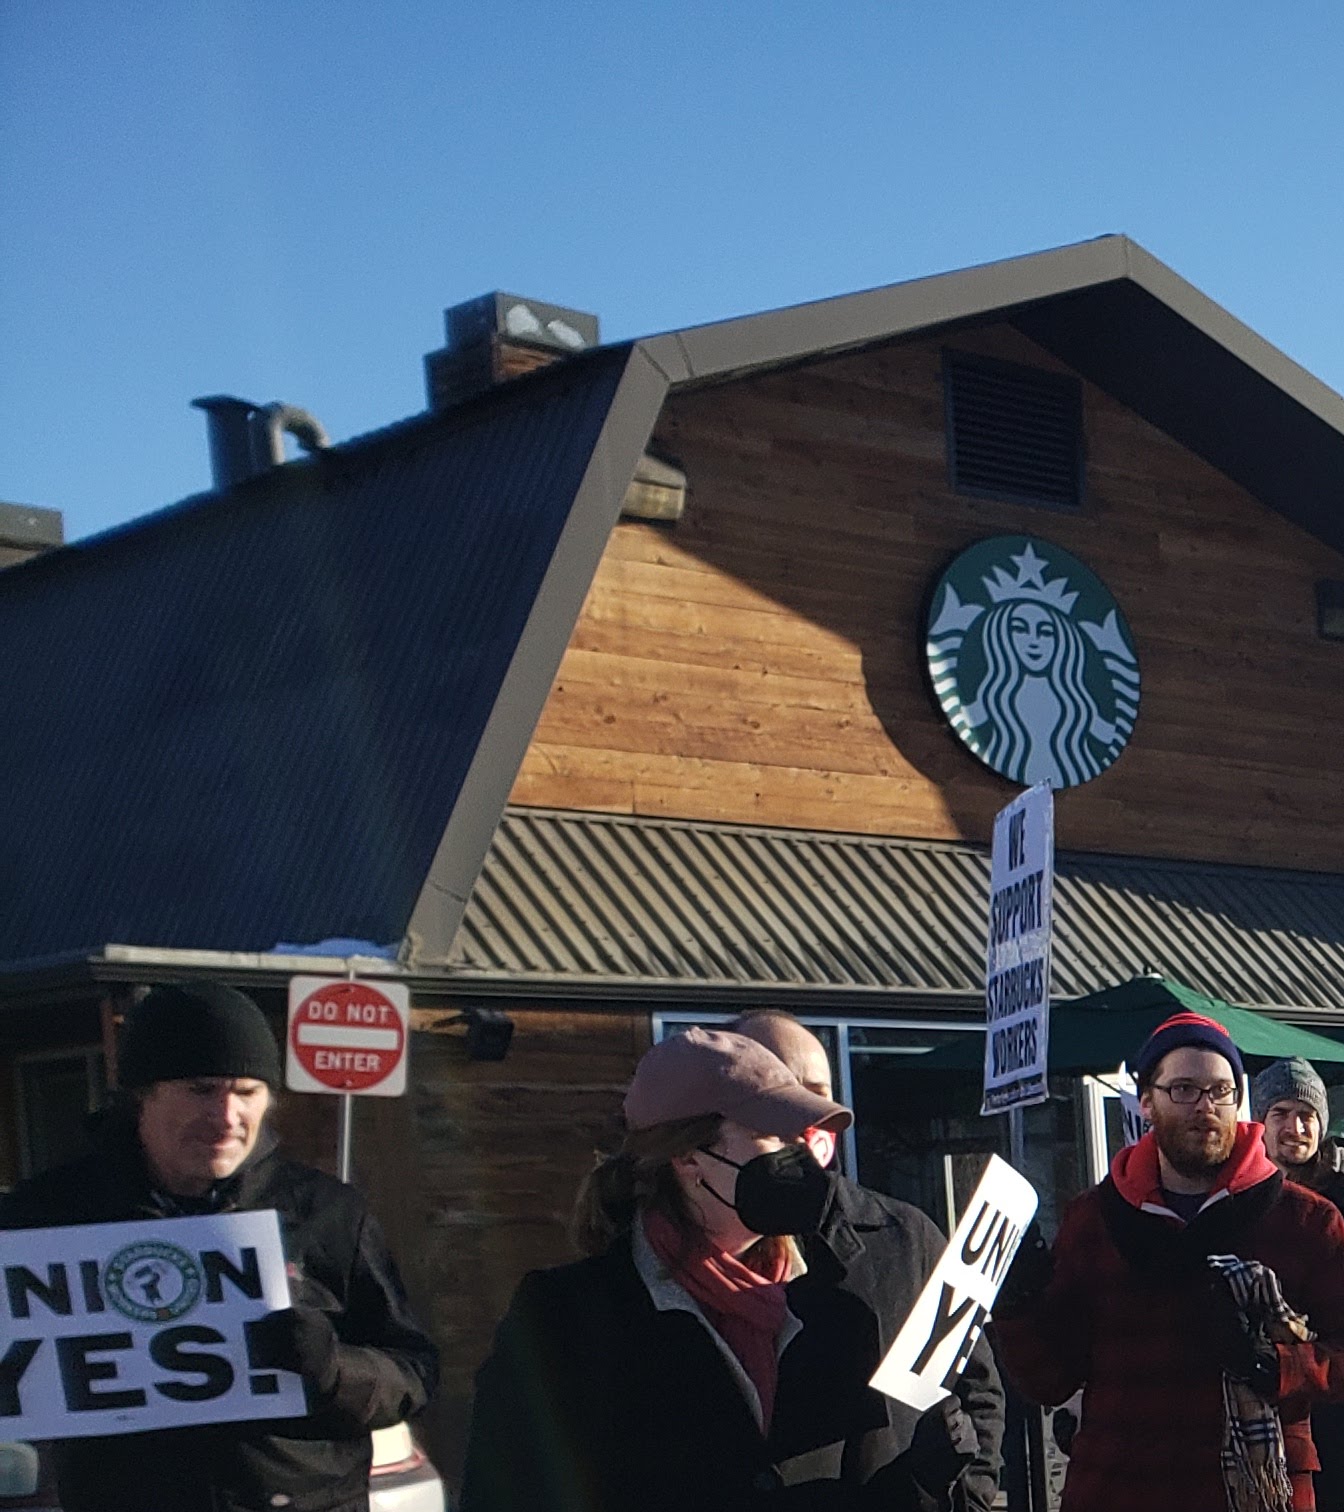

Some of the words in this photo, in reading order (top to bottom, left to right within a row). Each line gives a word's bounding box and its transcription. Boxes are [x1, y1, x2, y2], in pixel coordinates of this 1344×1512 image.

[1008, 808, 1026, 873] WE
[991, 868, 1044, 949] SUPPORT
[308, 1001, 338, 1021] DO
[347, 1003, 391, 1024] NOT
[314, 1051, 380, 1072] ENTER
